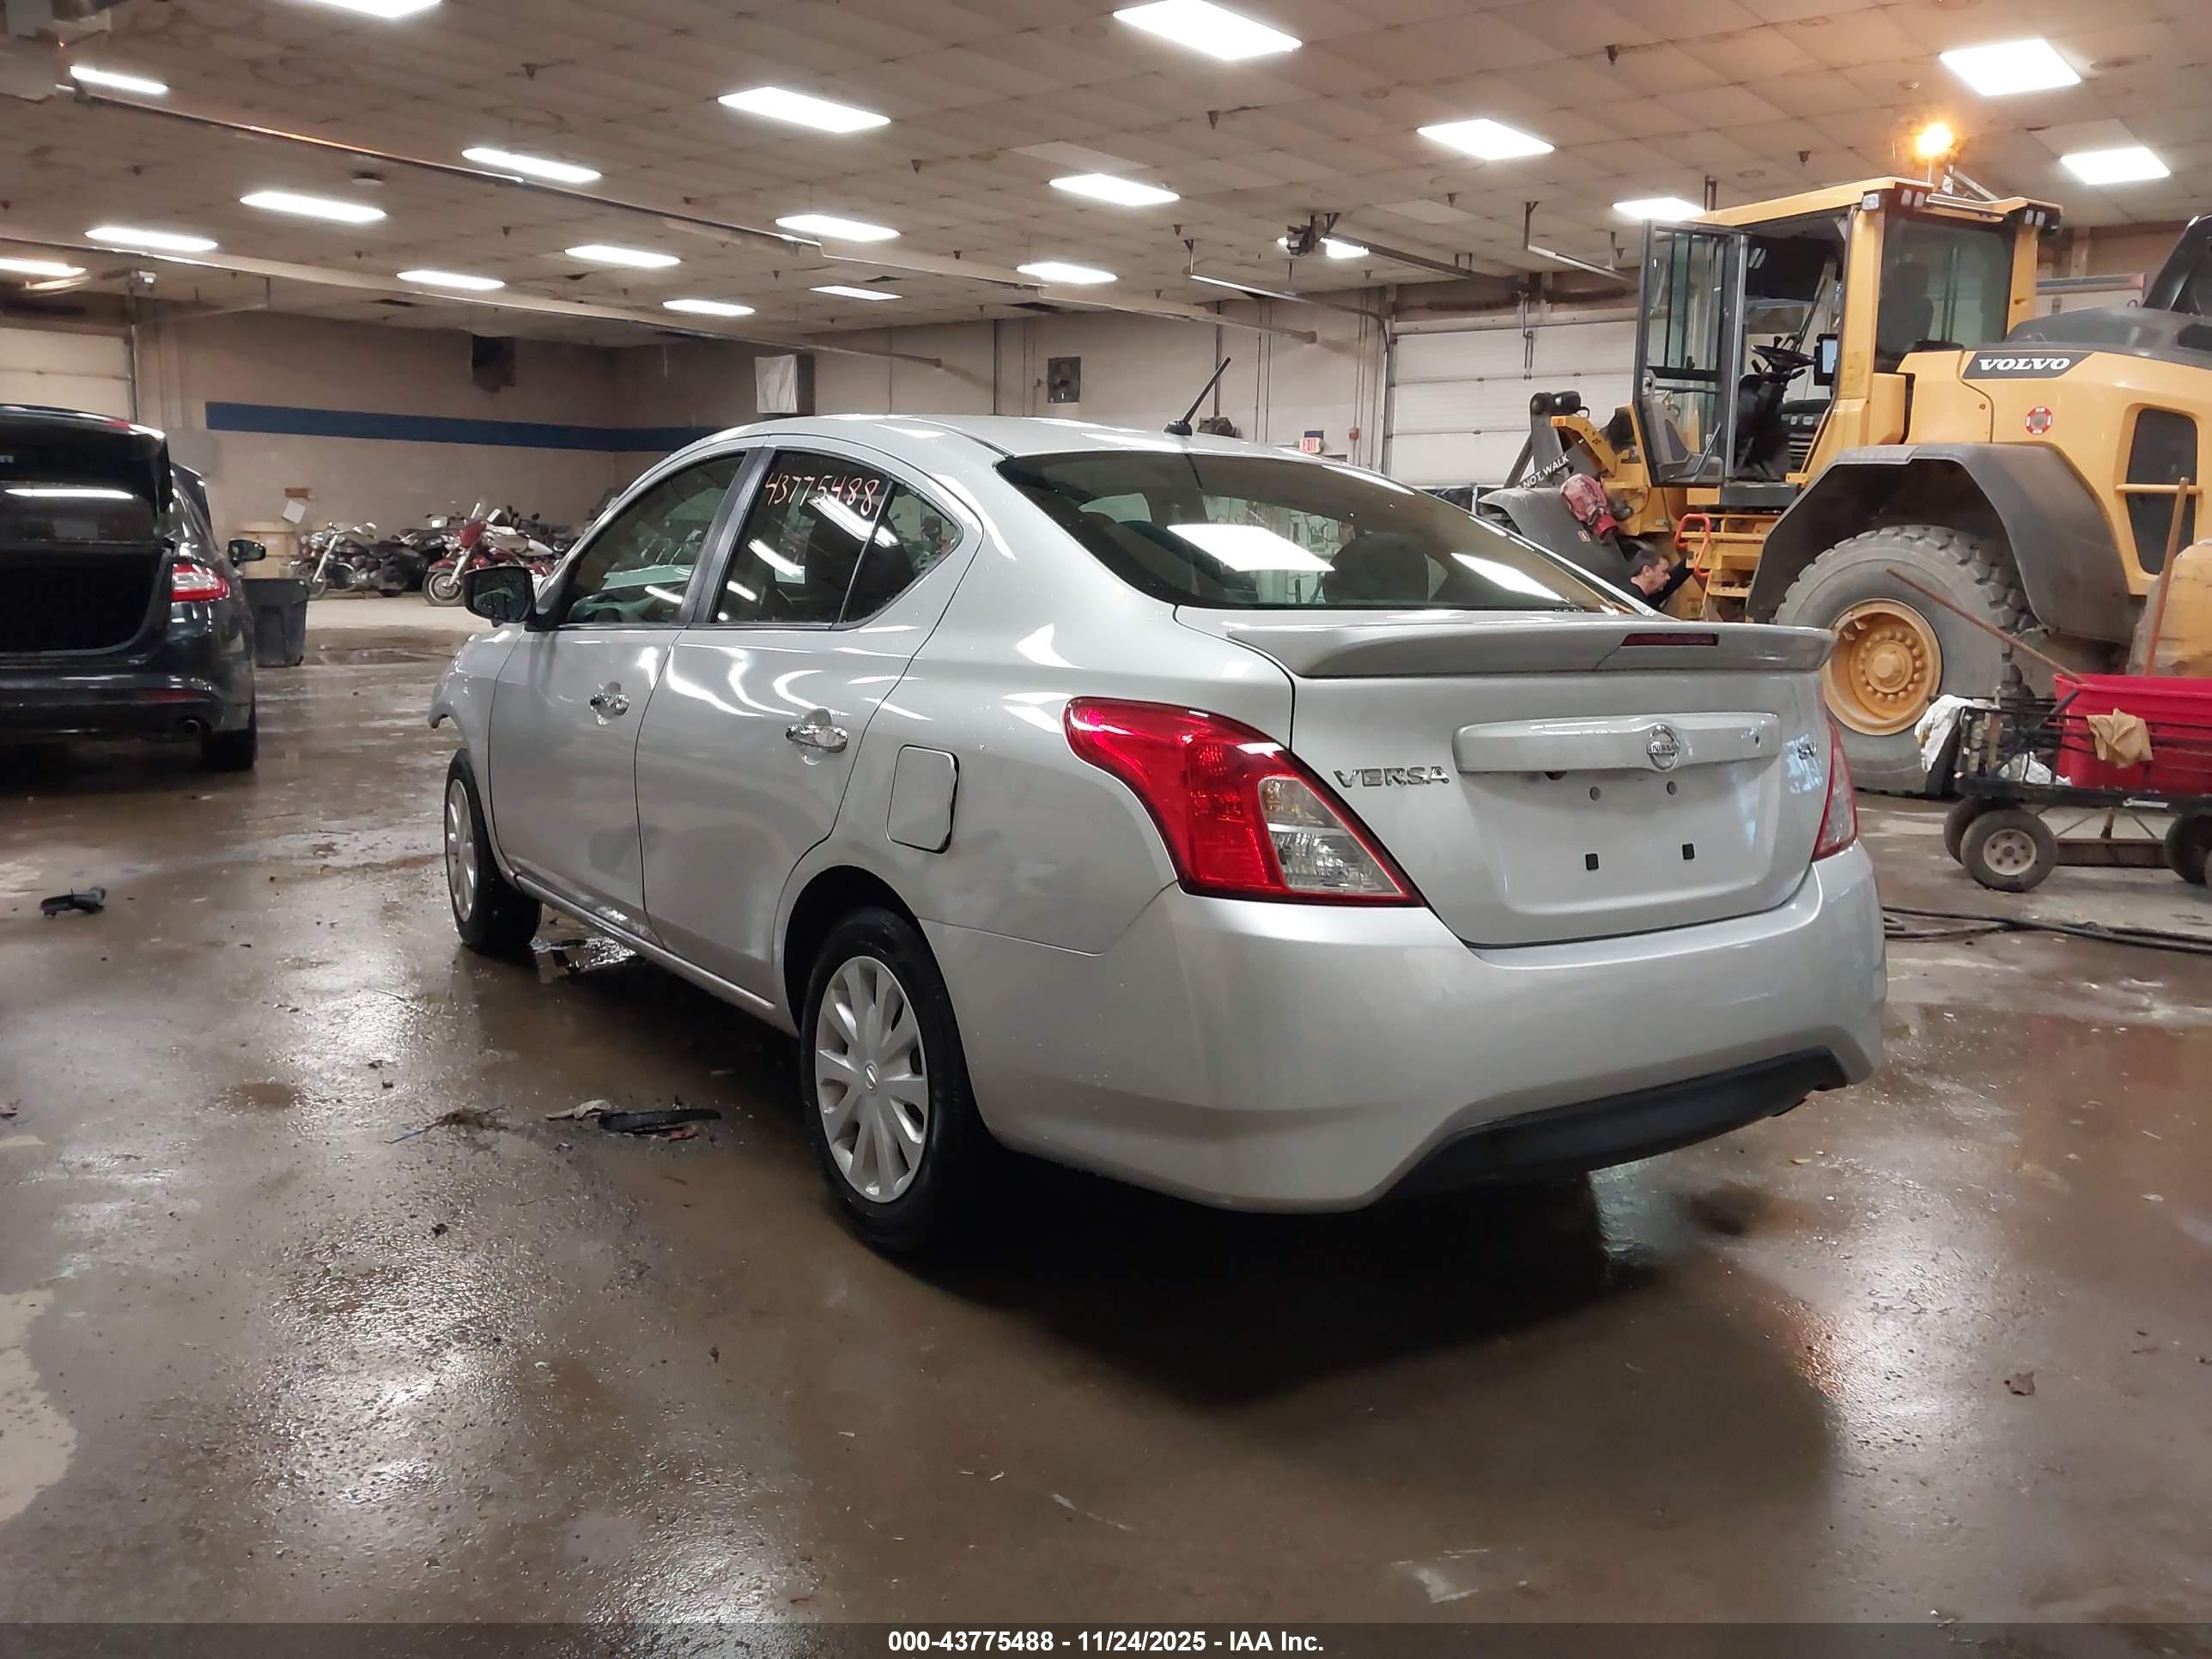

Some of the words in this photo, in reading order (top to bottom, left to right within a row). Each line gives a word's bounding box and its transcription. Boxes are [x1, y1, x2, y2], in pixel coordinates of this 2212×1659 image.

[1979, 358, 2070, 370] VOLVO
[1523, 471, 1541, 489] NOT
[1542, 454, 1570, 476] WALK
[765, 473, 880, 516] 43775488
[1797, 742, 1817, 760] SV
[1333, 766, 1449, 787] VERSA
